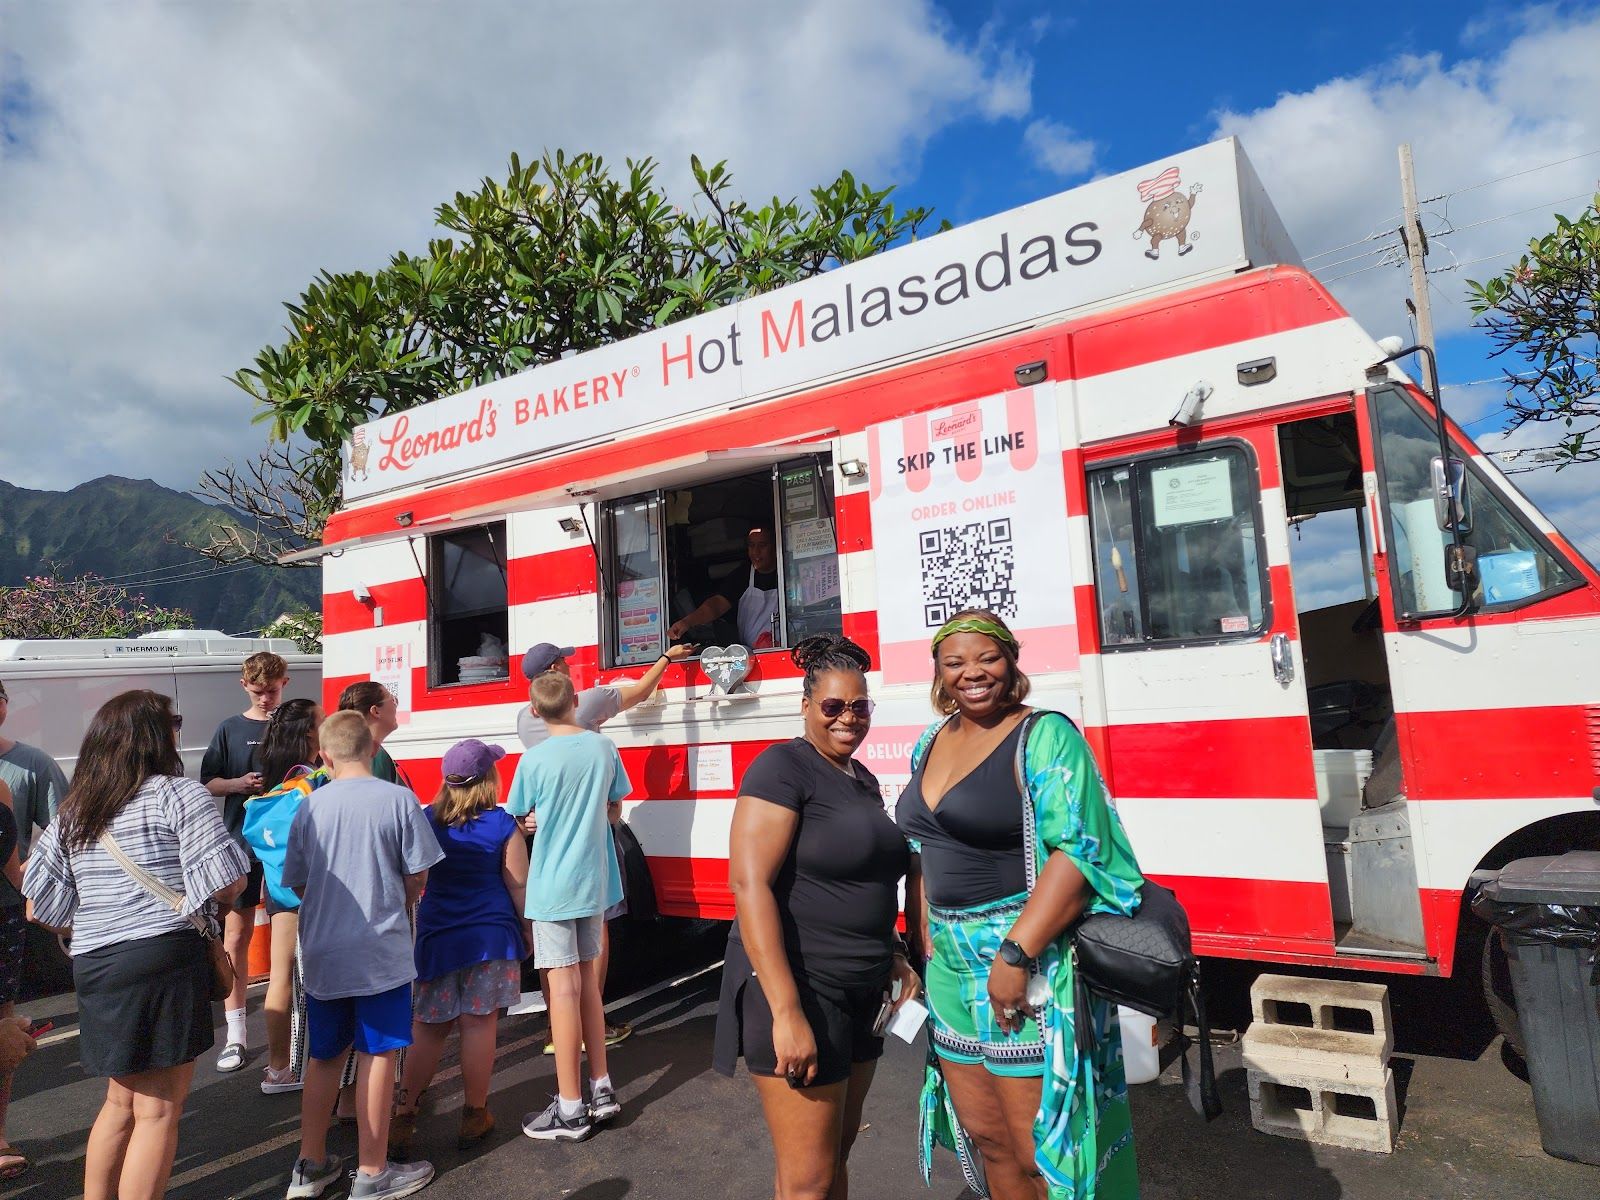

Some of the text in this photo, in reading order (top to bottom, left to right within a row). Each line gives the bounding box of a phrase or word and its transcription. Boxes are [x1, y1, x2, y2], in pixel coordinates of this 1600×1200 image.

[378, 398, 497, 471] Leonard's
[661, 324, 743, 387] Hot
[761, 220, 1103, 358] Malasadas
[897, 431, 1025, 474] SKIP THE LINE
[786, 474, 811, 487] PASS
[911, 491, 1017, 521] ORDER ONLINE
